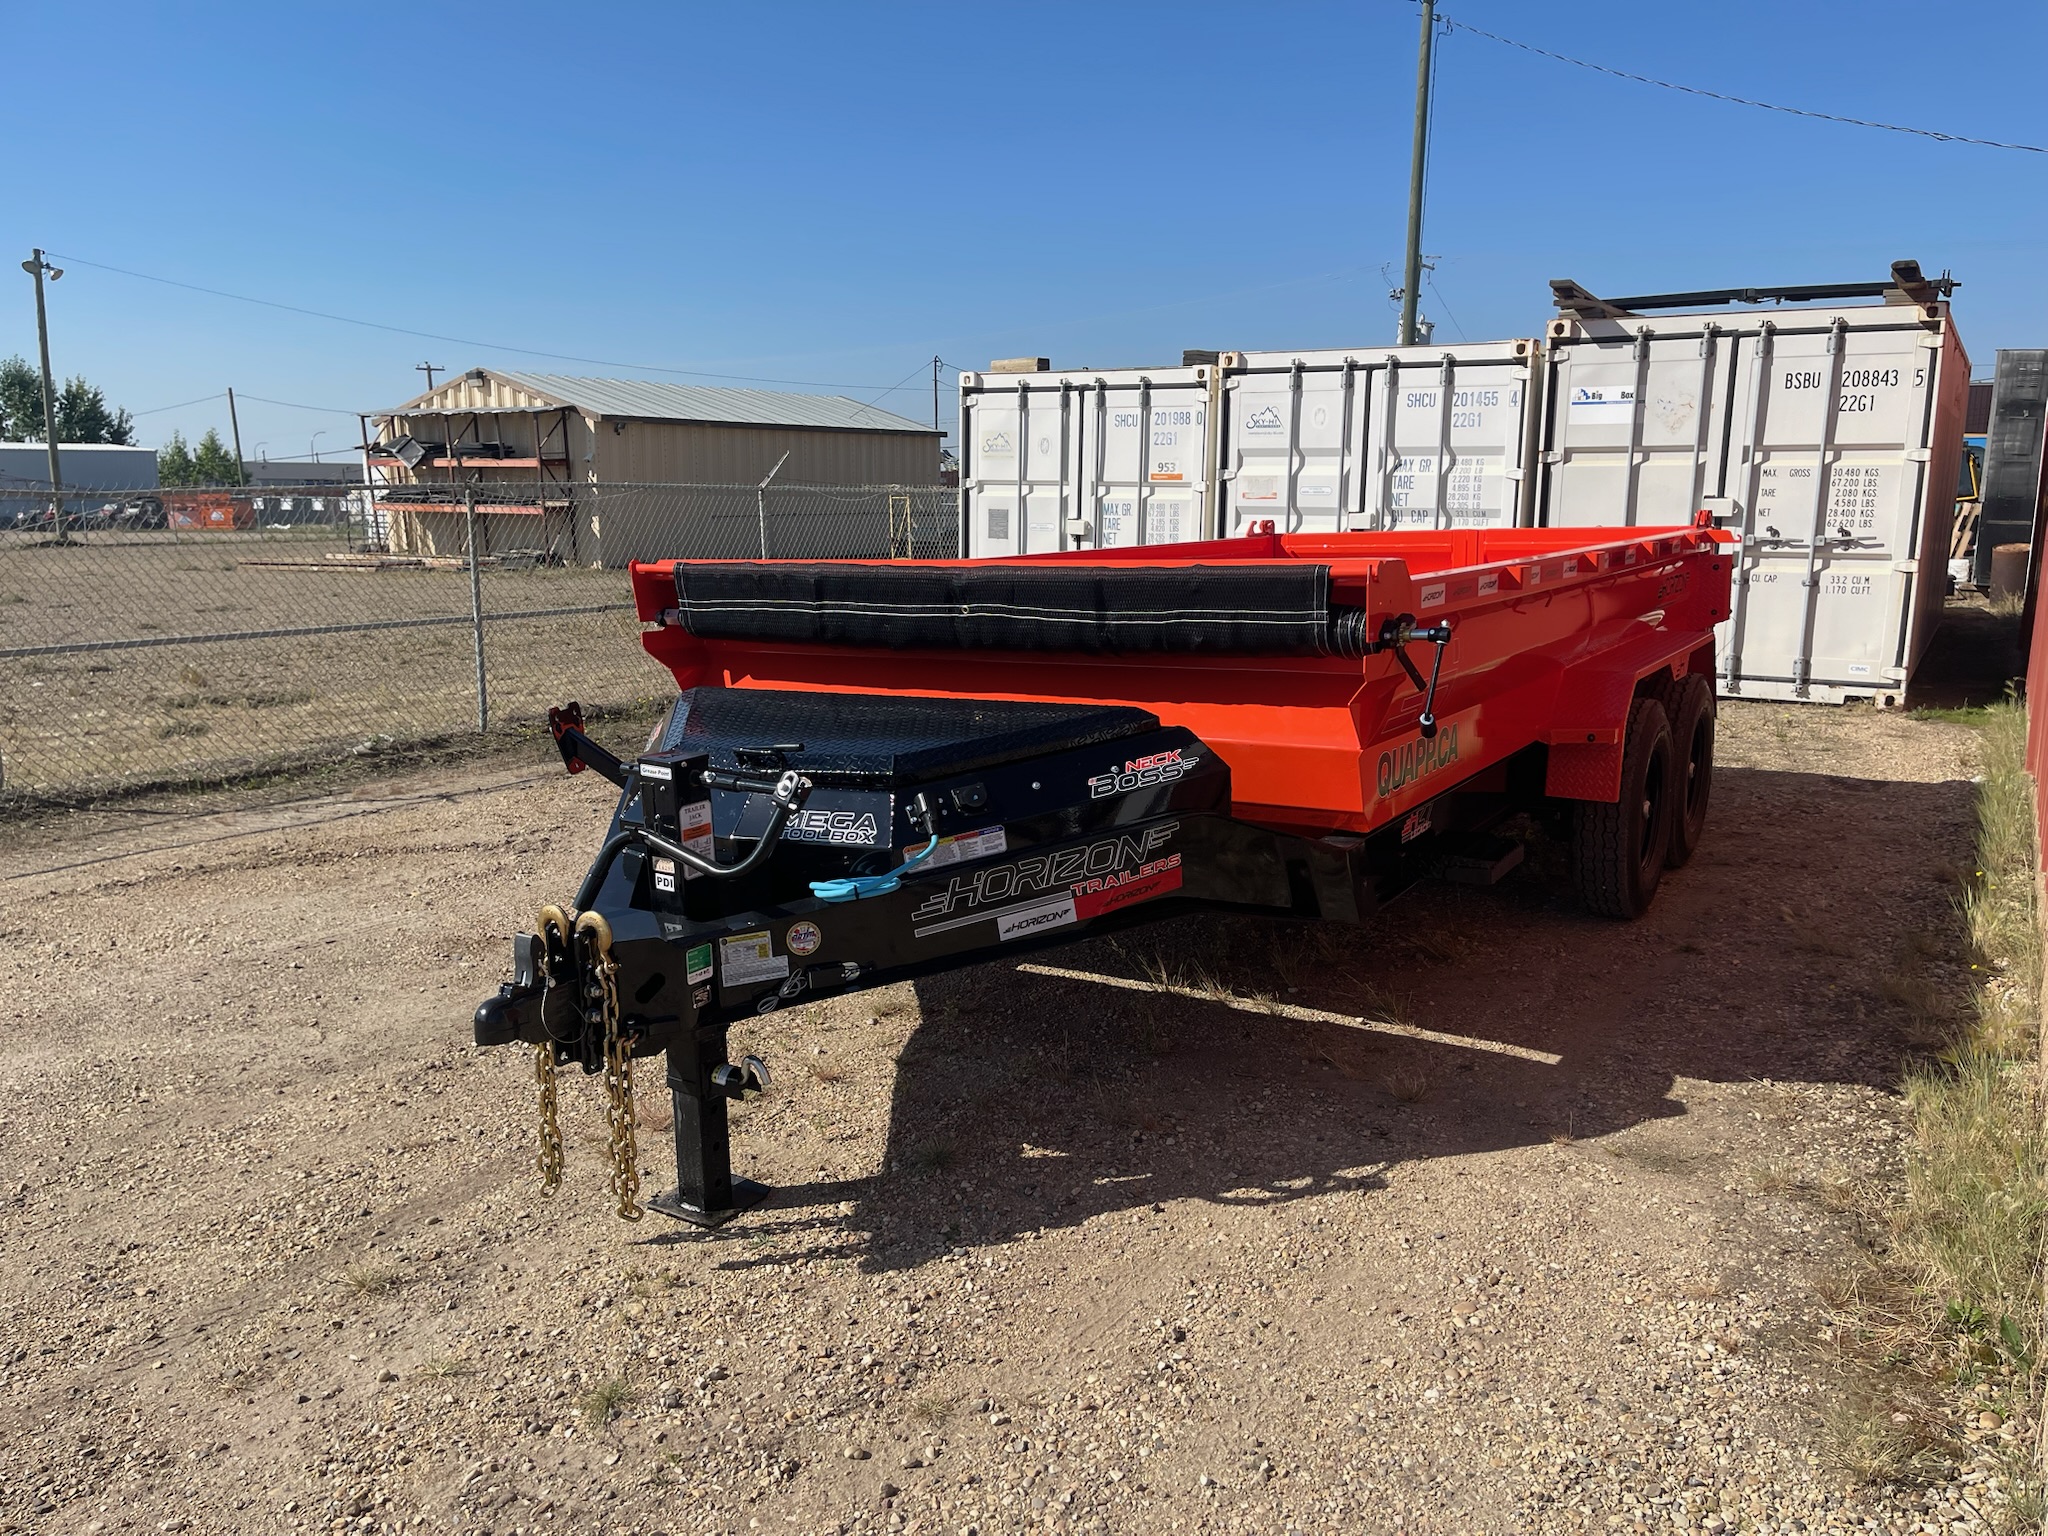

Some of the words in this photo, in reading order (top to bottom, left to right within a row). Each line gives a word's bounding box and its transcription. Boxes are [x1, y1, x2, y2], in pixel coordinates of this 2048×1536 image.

[1785, 372, 1821, 389] BSBU
[1841, 369, 1899, 387] 208843
[1915, 369, 1924, 386] 5
[1407, 393, 1436, 408] SHCU
[1453, 391, 1498, 407] 201455
[1510, 391, 1518, 407] 4
[1591, 390, 1603, 400] Big
[1620, 391, 1634, 399] Box
[1839, 395, 1875, 412] 22G1
[1114, 414, 1138, 428] SHCU
[1154, 412, 1191, 426] 201988
[1196, 411, 1203, 425] 0
[1453, 412, 1482, 428] 22G1
[1153, 432, 1178, 446] 22G1
[1157, 462, 1176, 473] 953
[1419, 459, 1434, 473] GR.
[1833, 468, 1861, 477] 30.480
[1789, 469, 1811, 478] GROSS
[1393, 475, 1415, 490] TARE
[1831, 479, 1860, 487] 67.200
[1761, 489, 1776, 497] TARE
[1835, 489, 1858, 497] 2.080
[1391, 493, 1409, 507] NET
[1834, 499, 1857, 507] 4.580
[1410, 510, 1432, 524] CAP.
[1758, 508, 1771, 517] NET
[1828, 509, 1856, 518] 28.400
[1104, 518, 1121, 530] TARE
[1826, 519, 1855, 528] 62.620
[1103, 532, 1117, 545] NET
[1830, 576, 1847, 584] 33.2
[1125, 749, 1182, 774] NECK
[641, 767, 657, 776] Grease
[657, 769, 670, 777] Point
[1089, 763, 1184, 798] BOSS
[684, 803, 706, 815] TRAILER
[689, 812, 703, 822] JACK
[786, 810, 877, 834] MEGA
[925, 829, 1158, 914] HORIZON
[1071, 853, 1182, 897] TRAILERS
[657, 876, 674, 890] PDI
[1005, 910, 1068, 934] HORIZON
